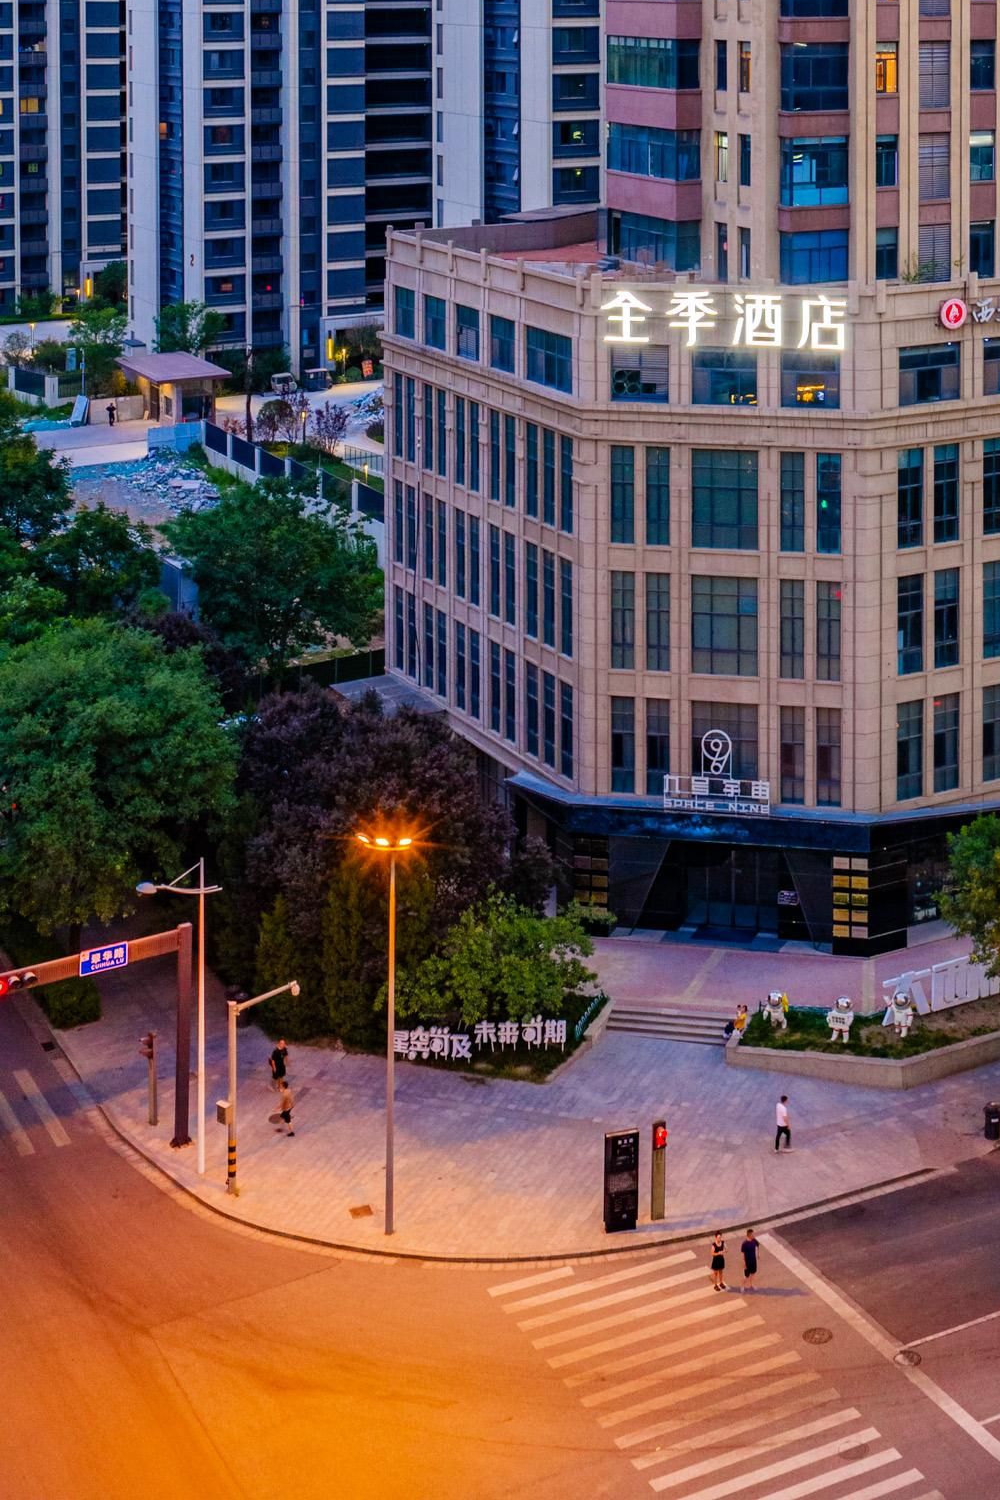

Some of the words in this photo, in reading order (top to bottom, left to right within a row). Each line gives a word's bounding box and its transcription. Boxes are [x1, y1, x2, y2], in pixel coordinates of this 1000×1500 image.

[600, 291, 847, 350] 全季酒店
[664, 799, 715, 811] SPACE
[729, 803, 769, 814] NINE
[91, 960, 115, 971] CUIHUA
[473, 1014, 567, 1045] 未来可期
